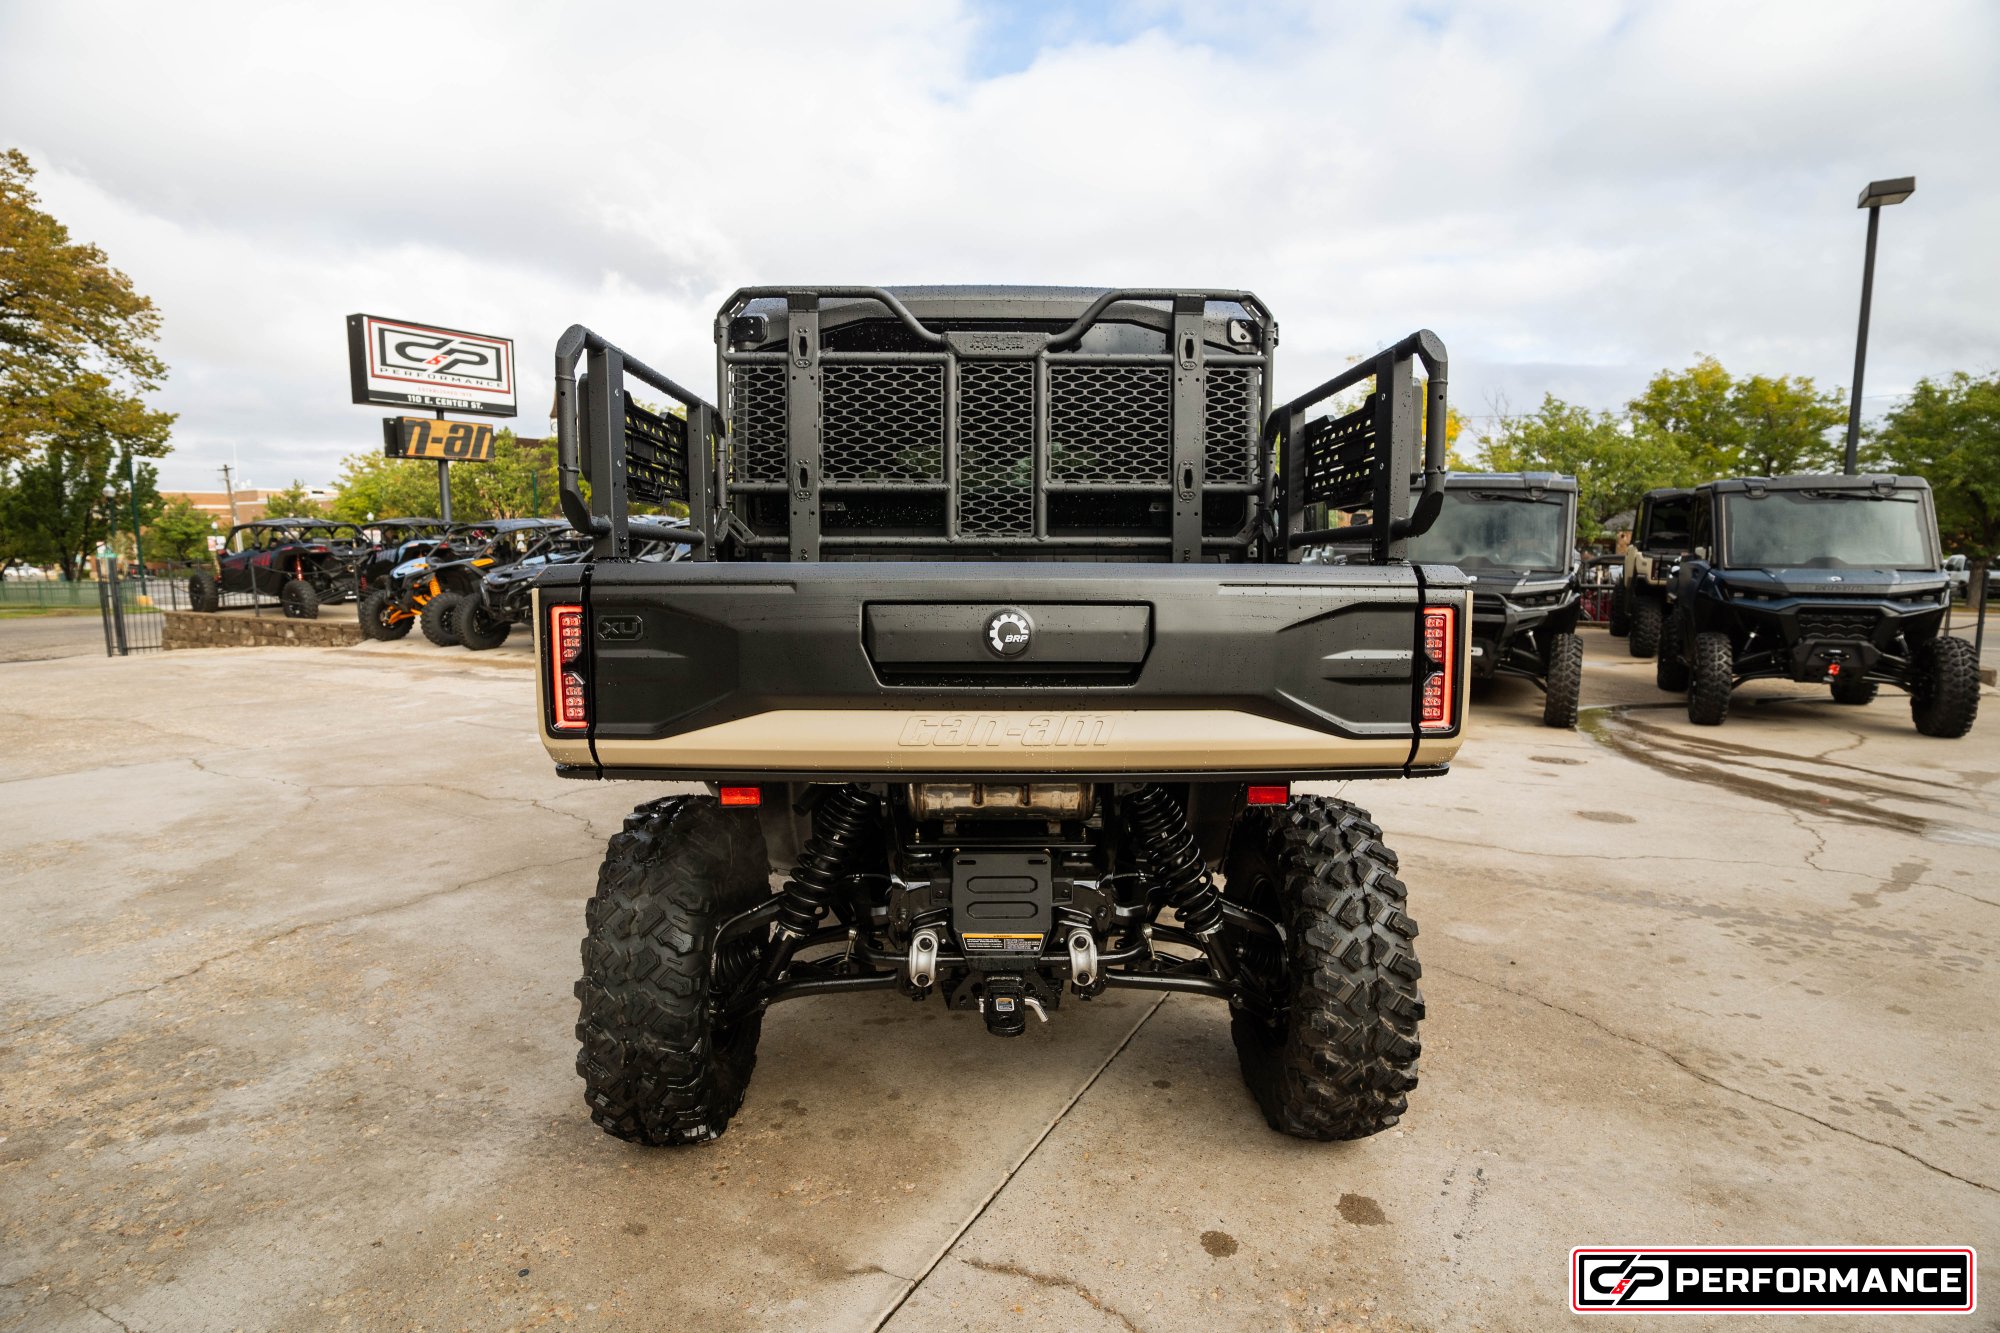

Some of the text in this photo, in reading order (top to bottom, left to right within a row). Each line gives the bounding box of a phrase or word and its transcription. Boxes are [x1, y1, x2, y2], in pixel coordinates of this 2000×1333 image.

[380, 367, 503, 388] PERFORMANCE
[407, 394, 484, 410] 110 E. CENTER ST.
[601, 622, 638, 634] XU
[1005, 634, 1029, 643] BRP
[898, 714, 1117, 747] can-am
